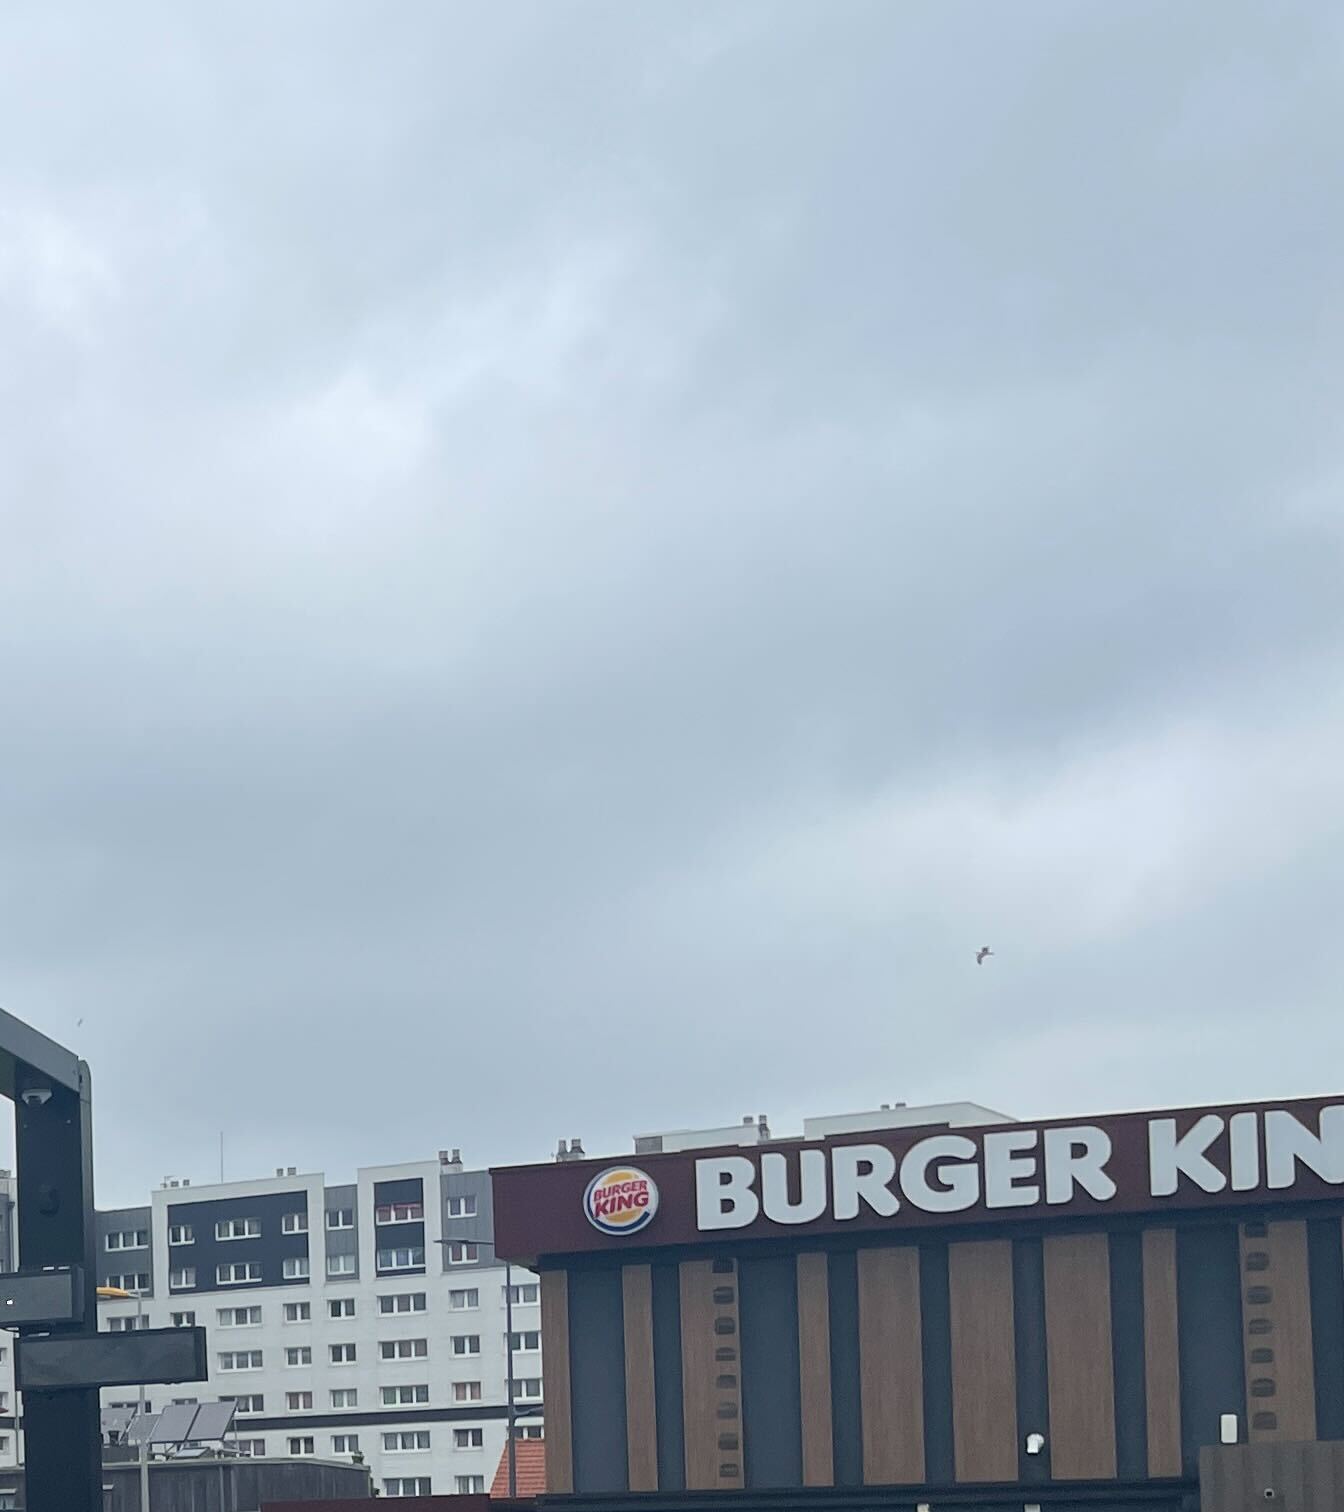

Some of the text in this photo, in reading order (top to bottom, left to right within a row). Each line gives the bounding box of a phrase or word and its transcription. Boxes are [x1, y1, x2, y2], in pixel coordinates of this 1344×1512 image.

[593, 1180, 648, 1202] BURGER
[695, 1125, 1117, 1231] BURGER
[594, 1192, 649, 1218] KING
